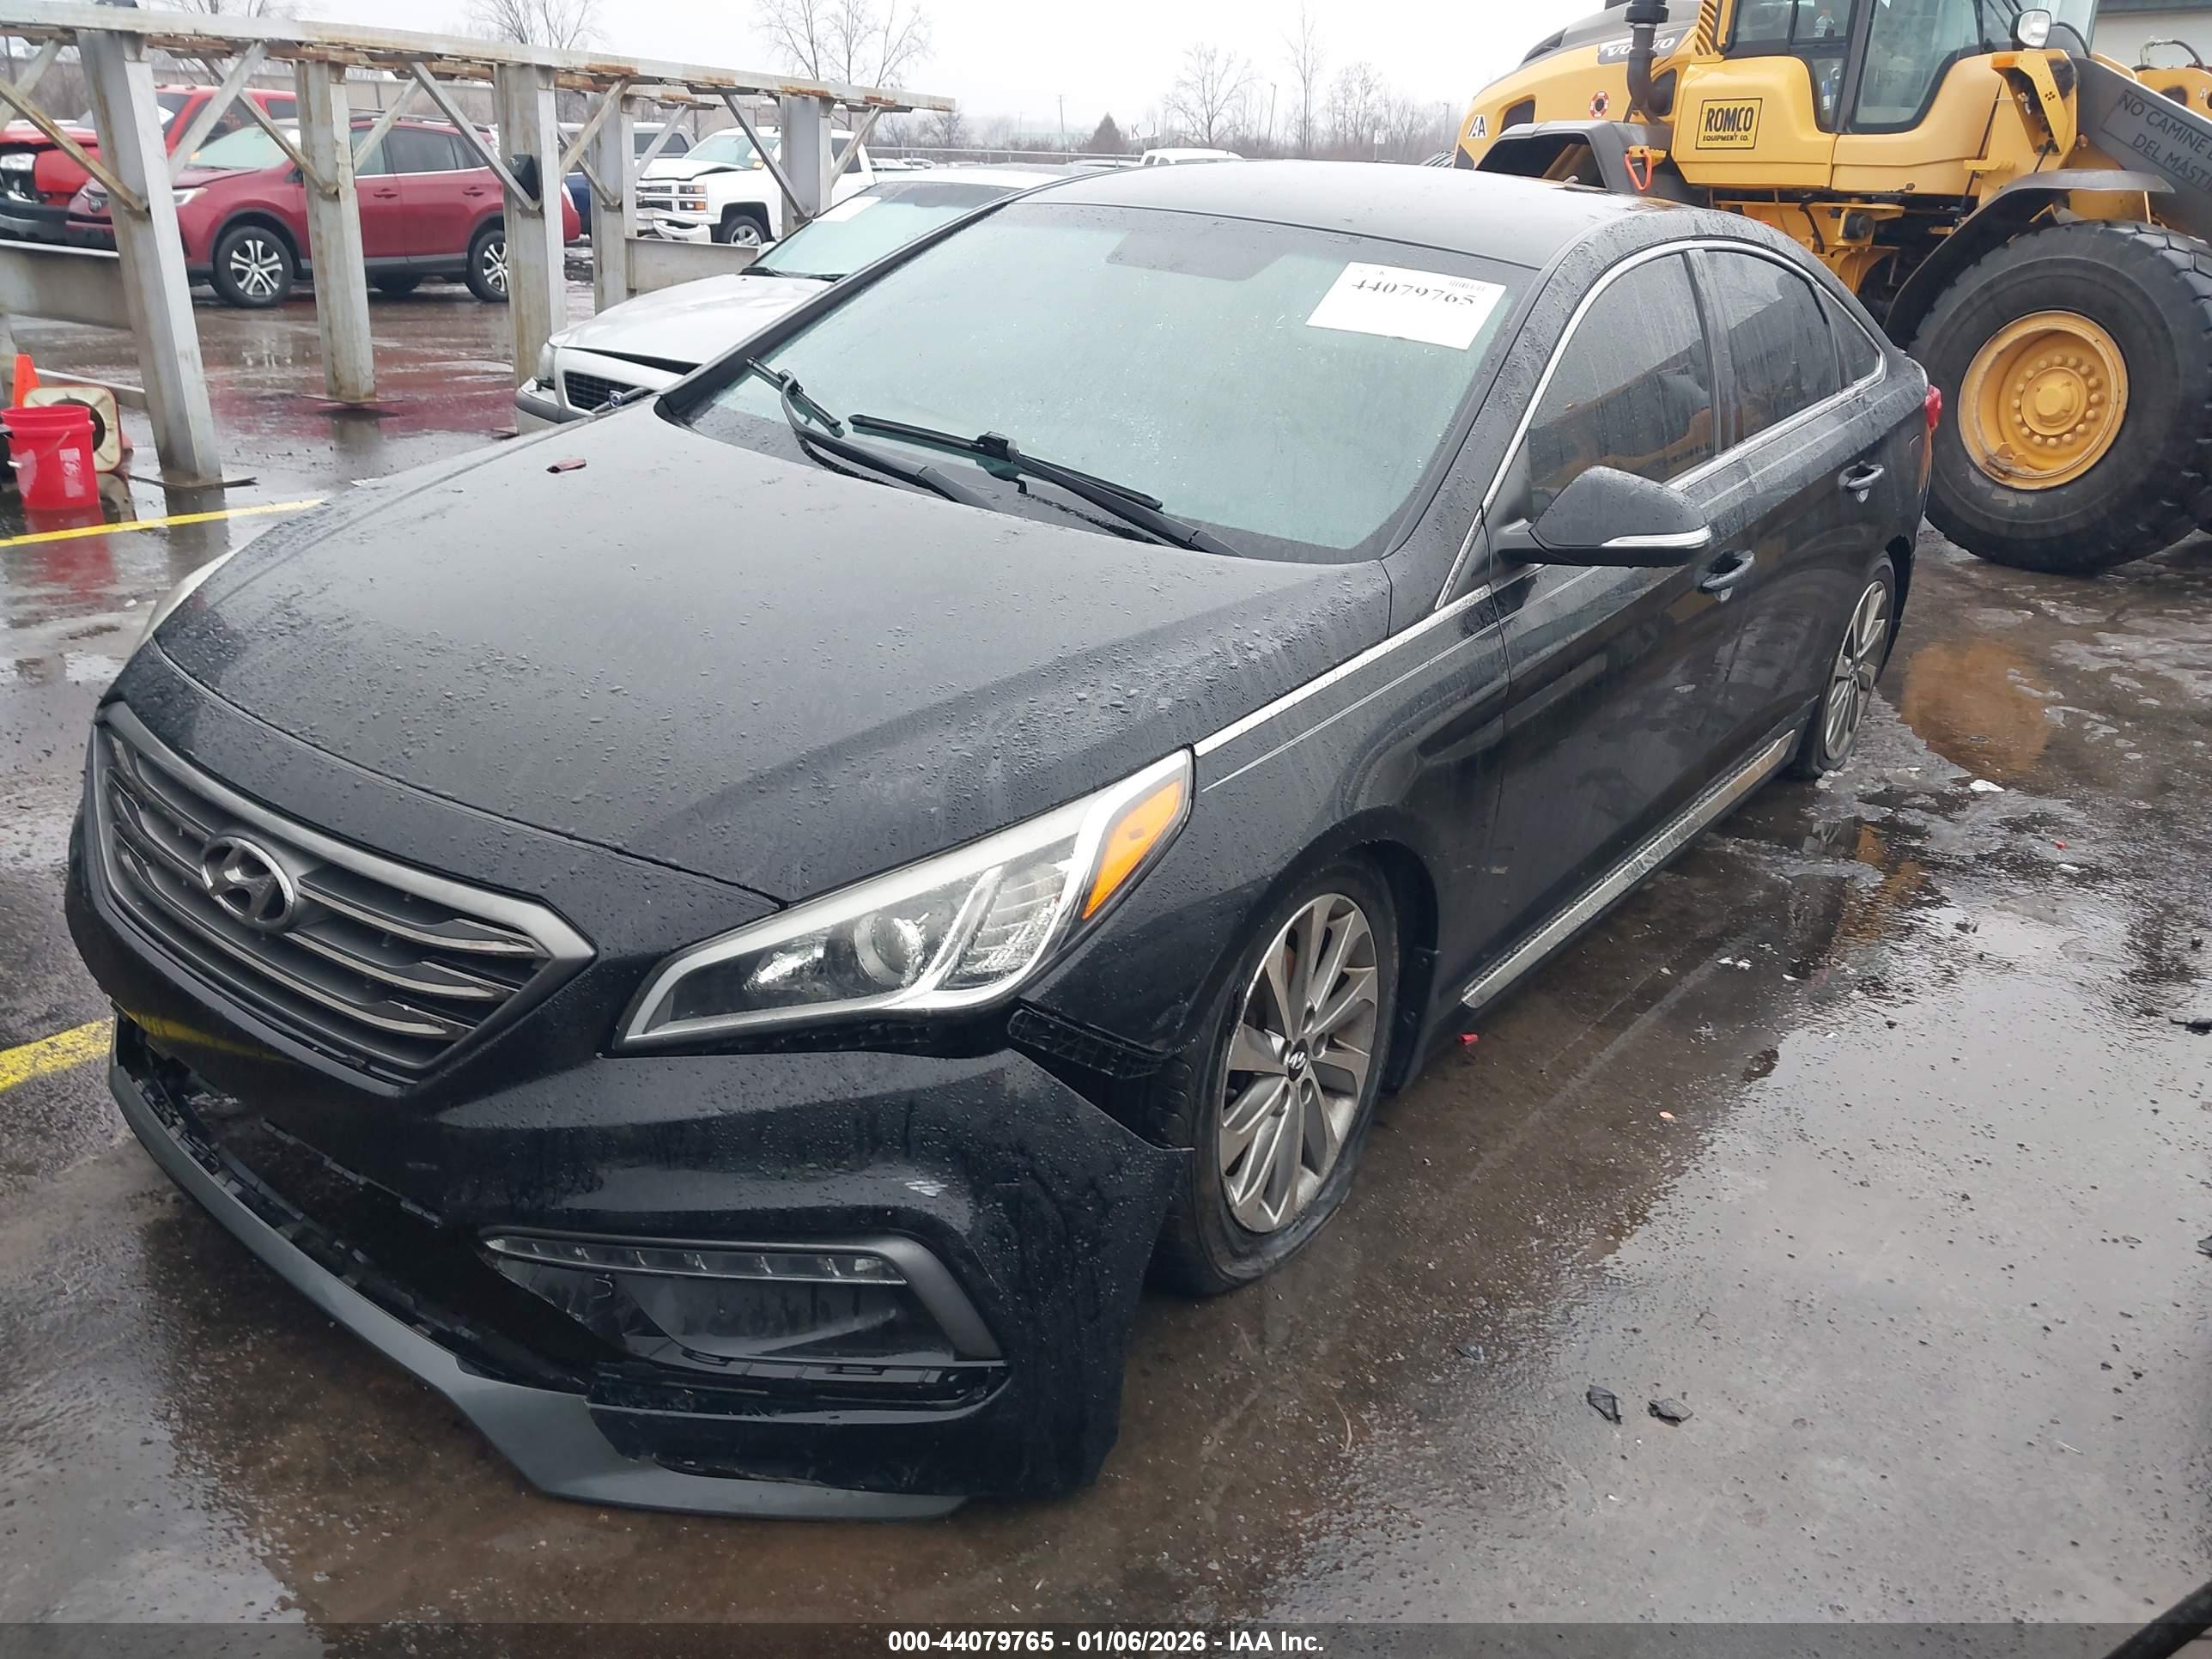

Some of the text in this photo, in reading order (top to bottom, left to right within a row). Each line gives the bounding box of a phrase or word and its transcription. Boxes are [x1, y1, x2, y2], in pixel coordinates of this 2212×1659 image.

[1705, 106, 1754, 132] ROMCO
[2118, 94, 2209, 154] NO CAMINE
[2132, 133, 2212, 191] DEL MÁSTI
[1352, 279, 1477, 306] 44079765
